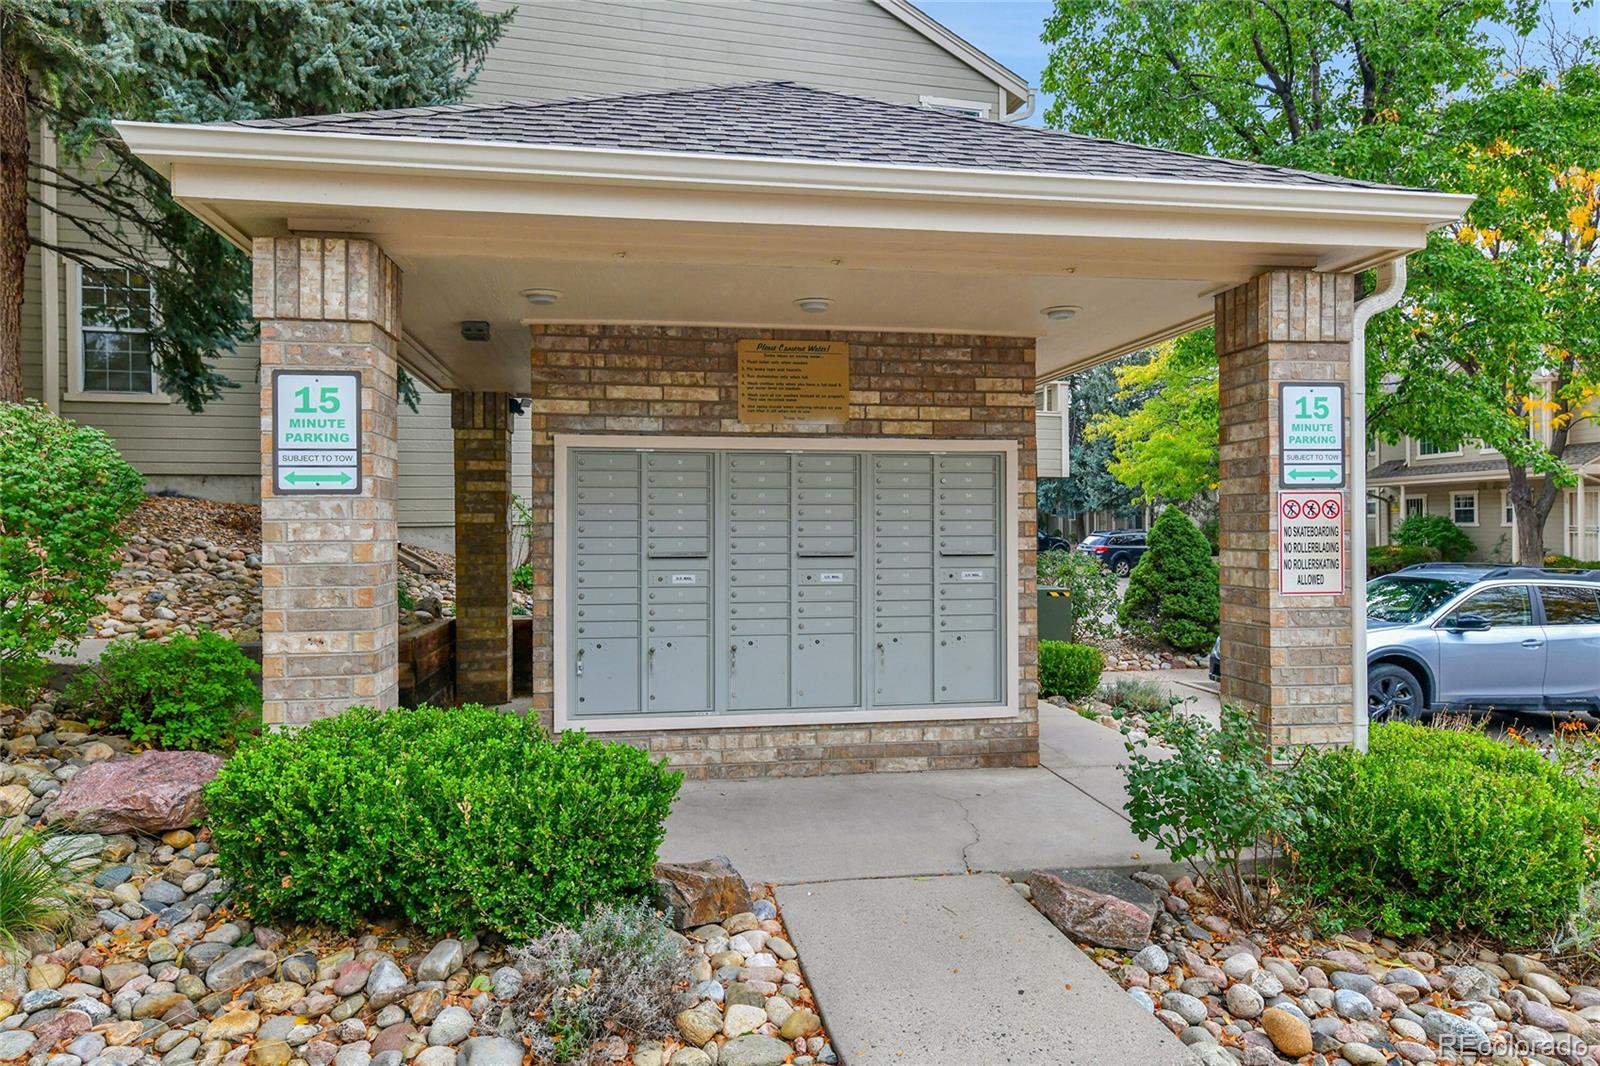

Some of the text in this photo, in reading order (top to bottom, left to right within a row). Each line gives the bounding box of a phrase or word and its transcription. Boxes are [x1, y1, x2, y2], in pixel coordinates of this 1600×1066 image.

[294, 386, 341, 414] 15
[1295, 396, 1330, 420] 15
[289, 419, 346, 429] MINUTE
[1291, 424, 1333, 432] MINUTE
[285, 433, 350, 443] PARKING
[1288, 436, 1337, 444] PARKING
[1283, 526, 1339, 537] NO SKATEBOARDING
[1283, 542, 1340, 553] NO ROLLERBLADING
[1283, 559, 1339, 570] NO ROLLERSKATING
[1297, 574, 1325, 585] ALLOWED
